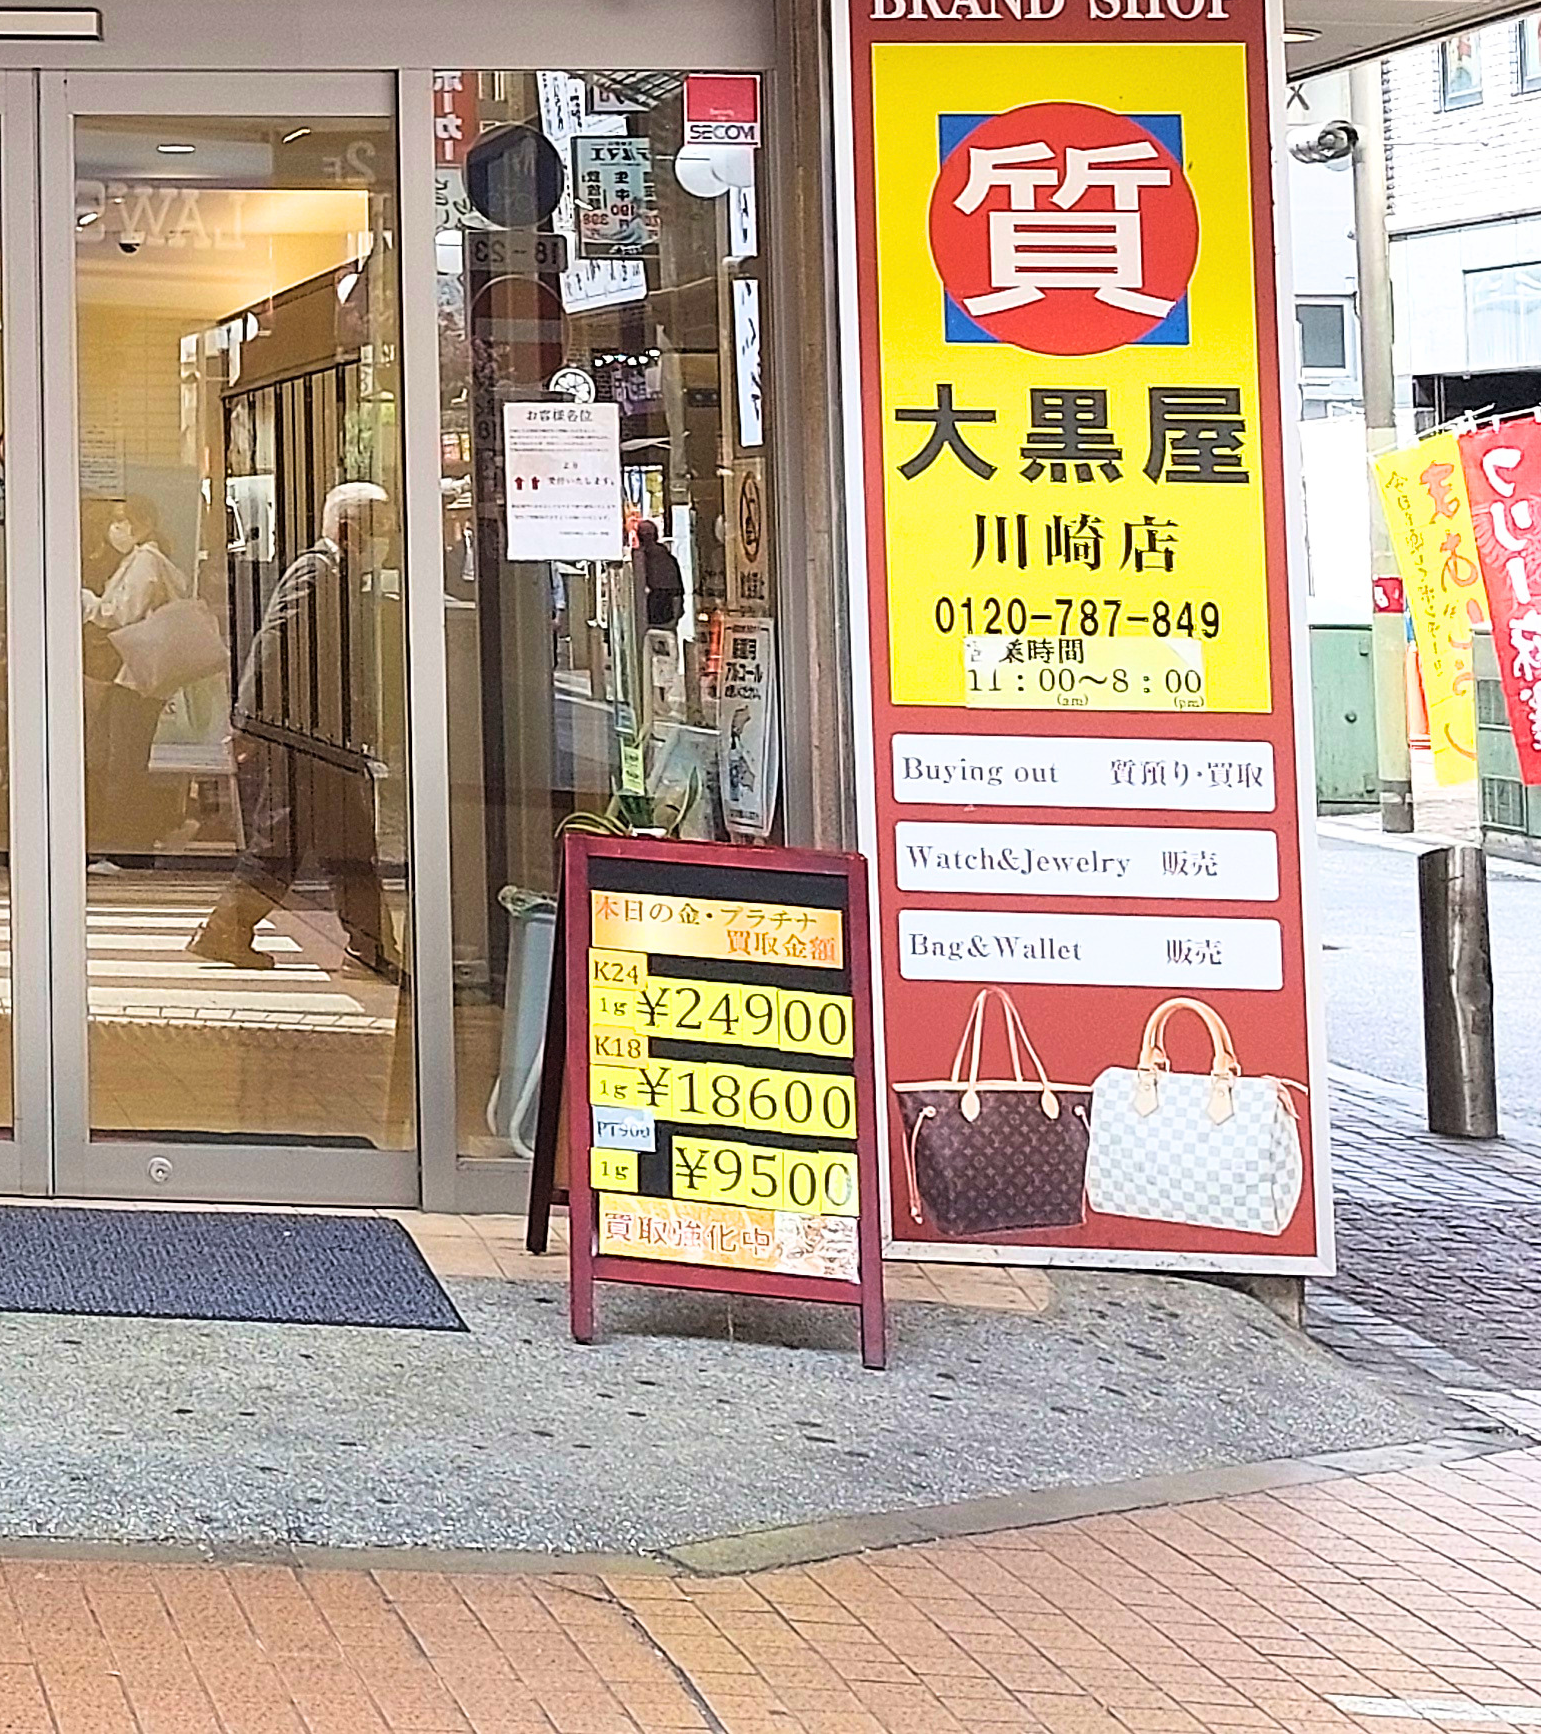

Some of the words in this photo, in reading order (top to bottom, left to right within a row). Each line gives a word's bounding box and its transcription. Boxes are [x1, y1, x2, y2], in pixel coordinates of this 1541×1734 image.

[690, 124, 755, 141] SECOM
[953, 141, 1176, 318] 質
[895, 383, 1249, 484] 大黒屋
[971, 513, 1178, 572] 川崎店
[935, 597, 1219, 639] 0120-787-849
[902, 756, 1003, 786] Buying
[1014, 762, 1059, 784] out
[906, 845, 1132, 878] Watch&Jewelry
[1161, 850, 1218, 877] 販売
[596, 896, 817, 931] 本日の金・プラチナ
[726, 929, 836, 962] 買取金額
[909, 932, 1082, 962] Bag&Wallet
[1166, 939, 1223, 965] 販売
[593, 962, 639, 985] K24
[600, 997, 628, 1016] 1g
[636, 987, 847, 1045] ¥24900
[595, 1035, 642, 1059] K18
[600, 1080, 628, 1099] 1g
[636, 1066, 851, 1129] ¥18600
[601, 1161, 629, 1180] 1g
[675, 1146, 852, 1207] ¥9500
[604, 1212, 772, 1256] 買取強化中
